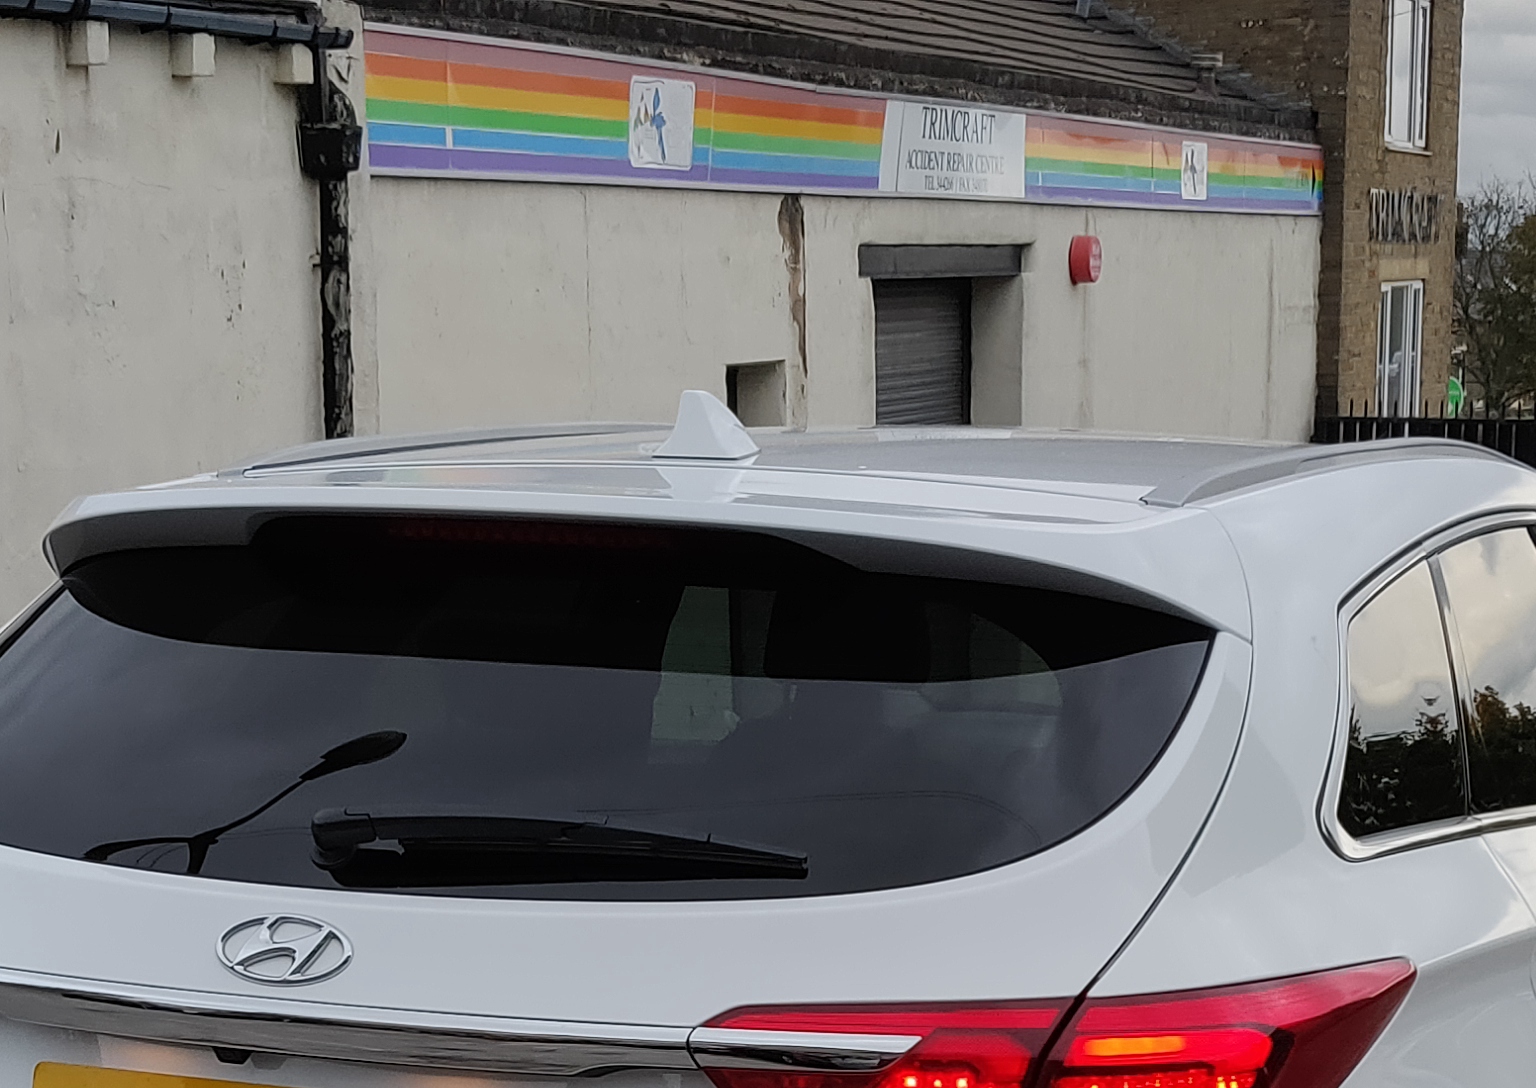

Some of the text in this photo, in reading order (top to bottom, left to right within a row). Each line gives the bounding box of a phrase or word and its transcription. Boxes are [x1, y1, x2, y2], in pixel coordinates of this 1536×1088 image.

[921, 105, 996, 144] TRIMCRAFT
[906, 148, 1005, 174] ACCIDENT REPAIR CENTRE
